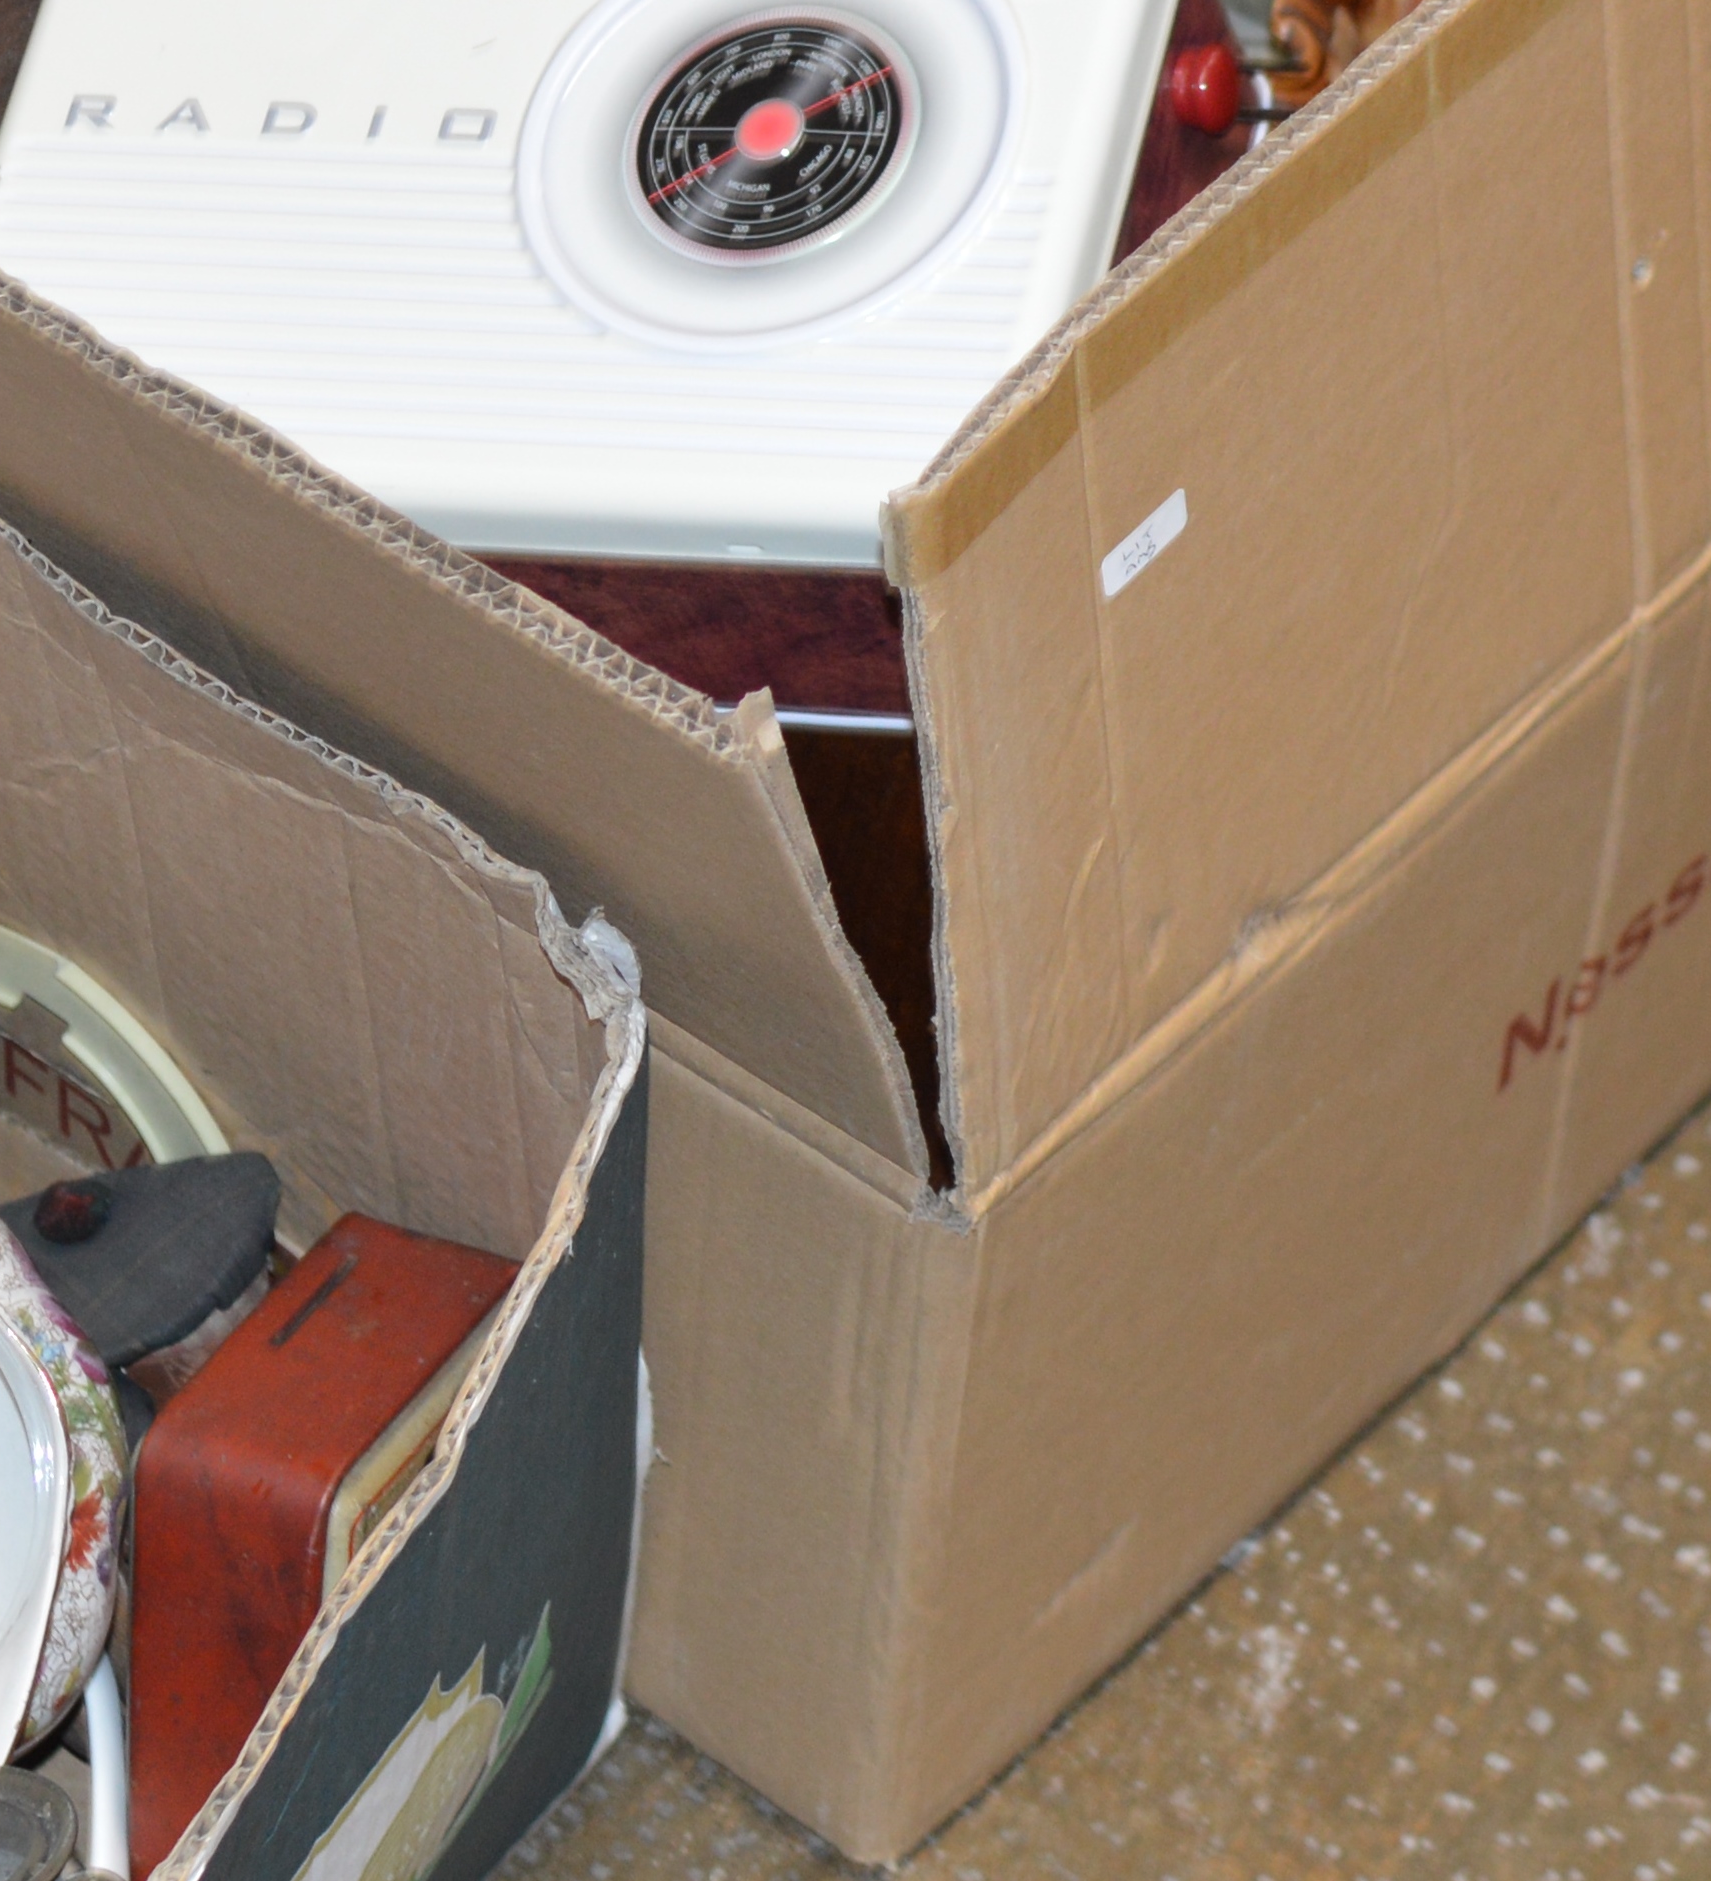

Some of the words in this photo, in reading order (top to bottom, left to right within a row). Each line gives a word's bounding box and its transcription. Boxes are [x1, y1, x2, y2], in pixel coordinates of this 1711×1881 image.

[751, 48, 792, 62] LONDON
[711, 64, 735, 85] LIGHT
[731, 60, 774, 81] MIDLAND
[64, 94, 498, 142] RADIO
[799, 144, 833, 177] CHICAGO
[727, 180, 771, 193] MICHIGAN
